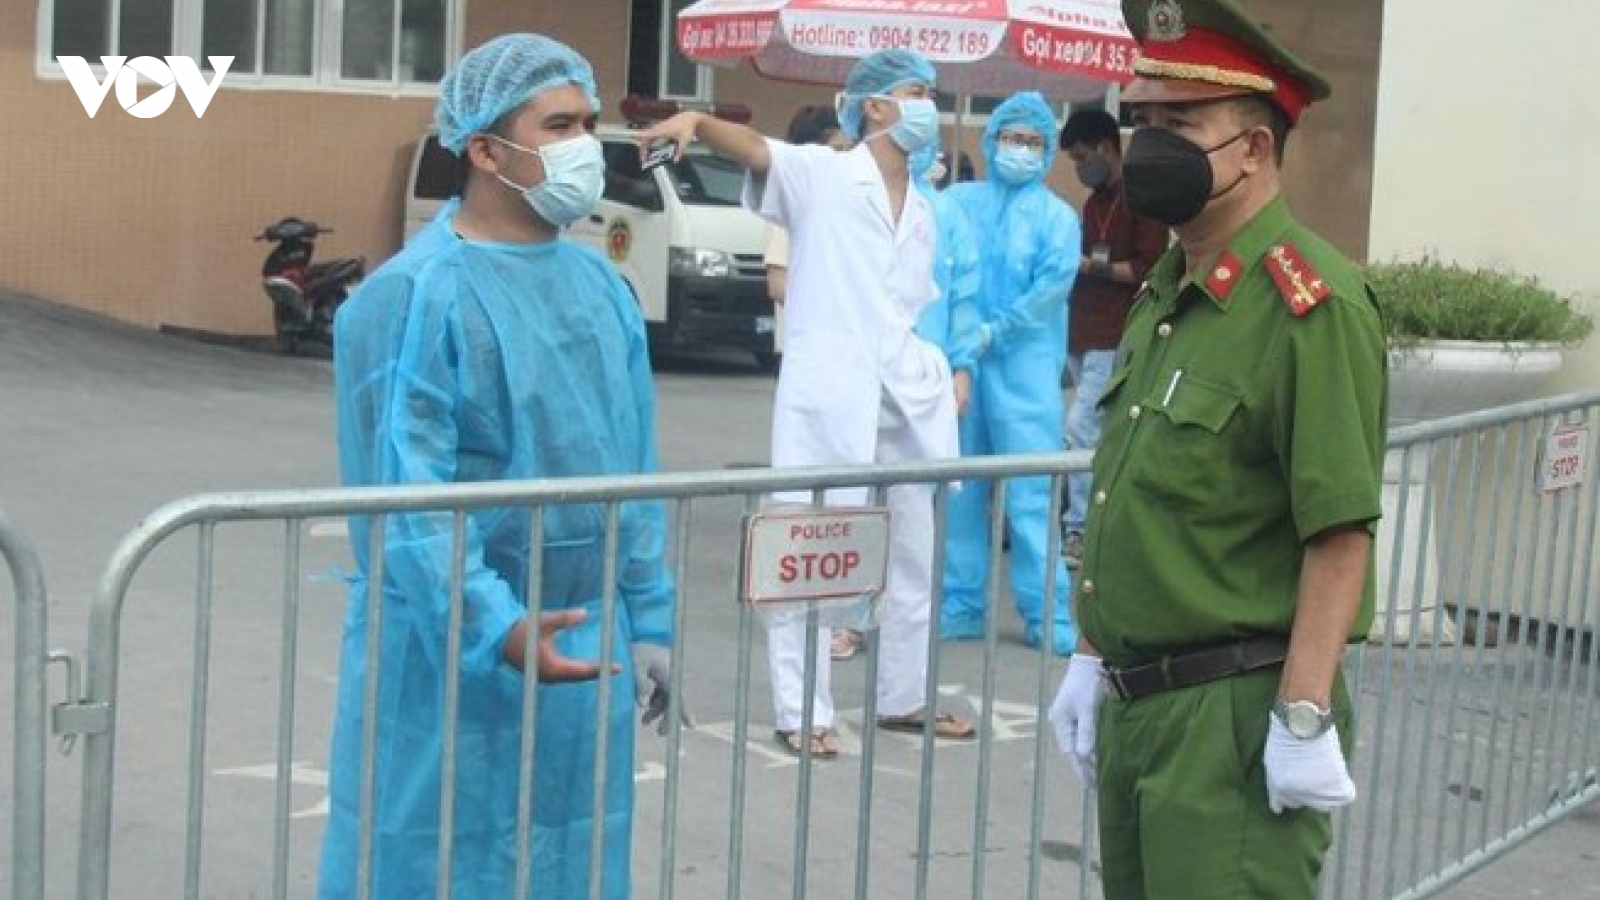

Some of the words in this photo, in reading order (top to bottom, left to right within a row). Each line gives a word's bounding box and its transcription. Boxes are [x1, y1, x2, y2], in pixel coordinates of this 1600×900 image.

[791, 22, 863, 47] Hotline:
[869, 25, 912, 49] 0904
[918, 28, 951, 53] 522
[957, 31, 989, 55] 189
[1551, 454, 1579, 477] STOP
[790, 521, 851, 541] POLICE
[778, 550, 860, 583] STOP
